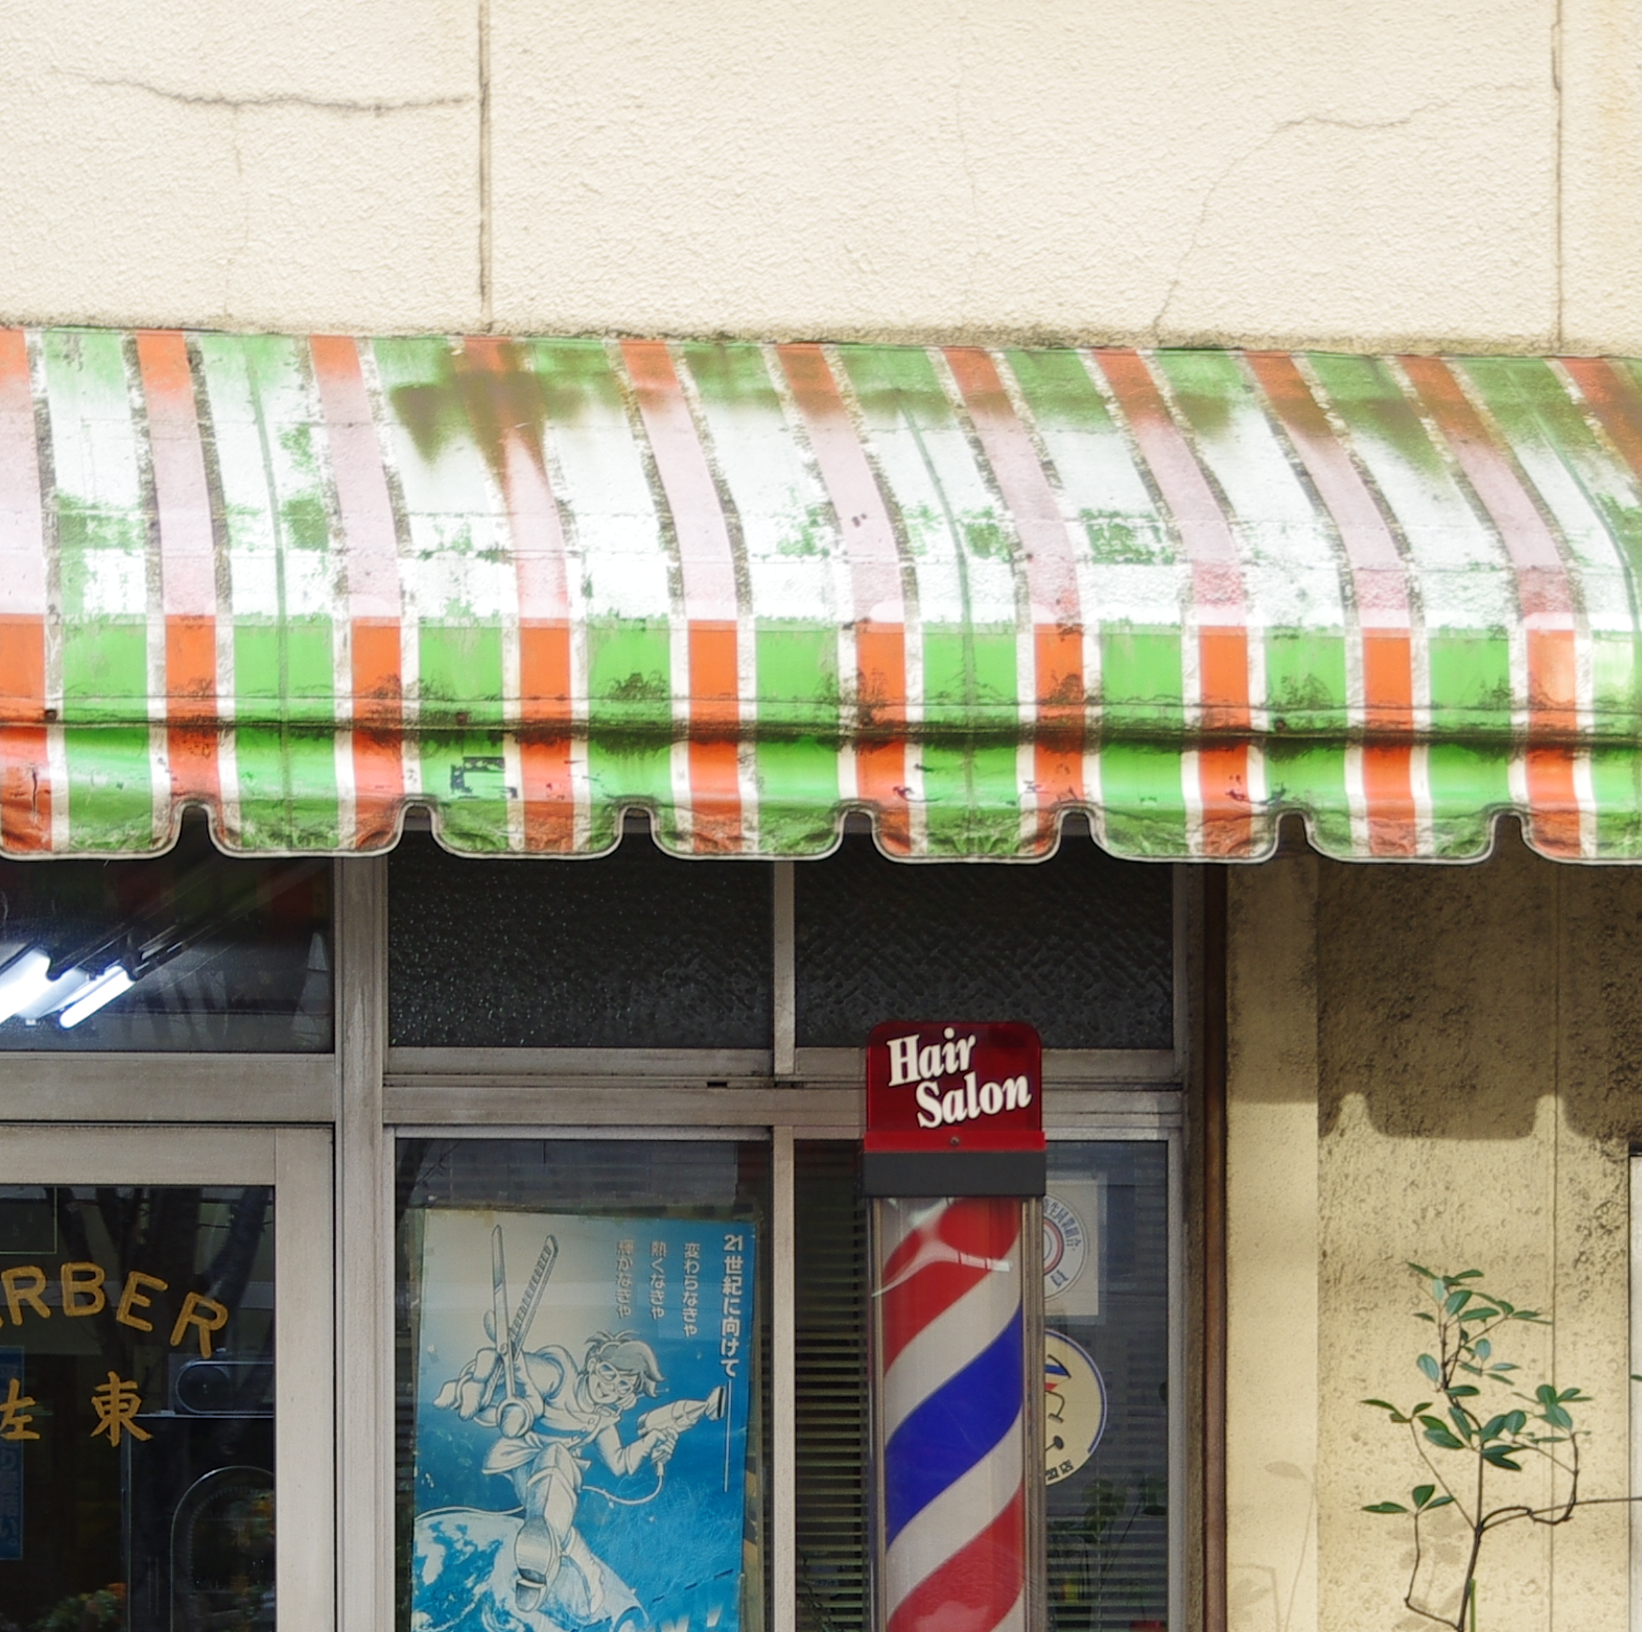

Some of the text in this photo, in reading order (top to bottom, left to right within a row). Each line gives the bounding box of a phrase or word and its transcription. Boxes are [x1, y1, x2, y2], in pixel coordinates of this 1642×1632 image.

[885, 1026, 977, 1087] Hair
[915, 1073, 1032, 1129] Salon
[682, 1242, 700, 1338] 変わらなきゃ
